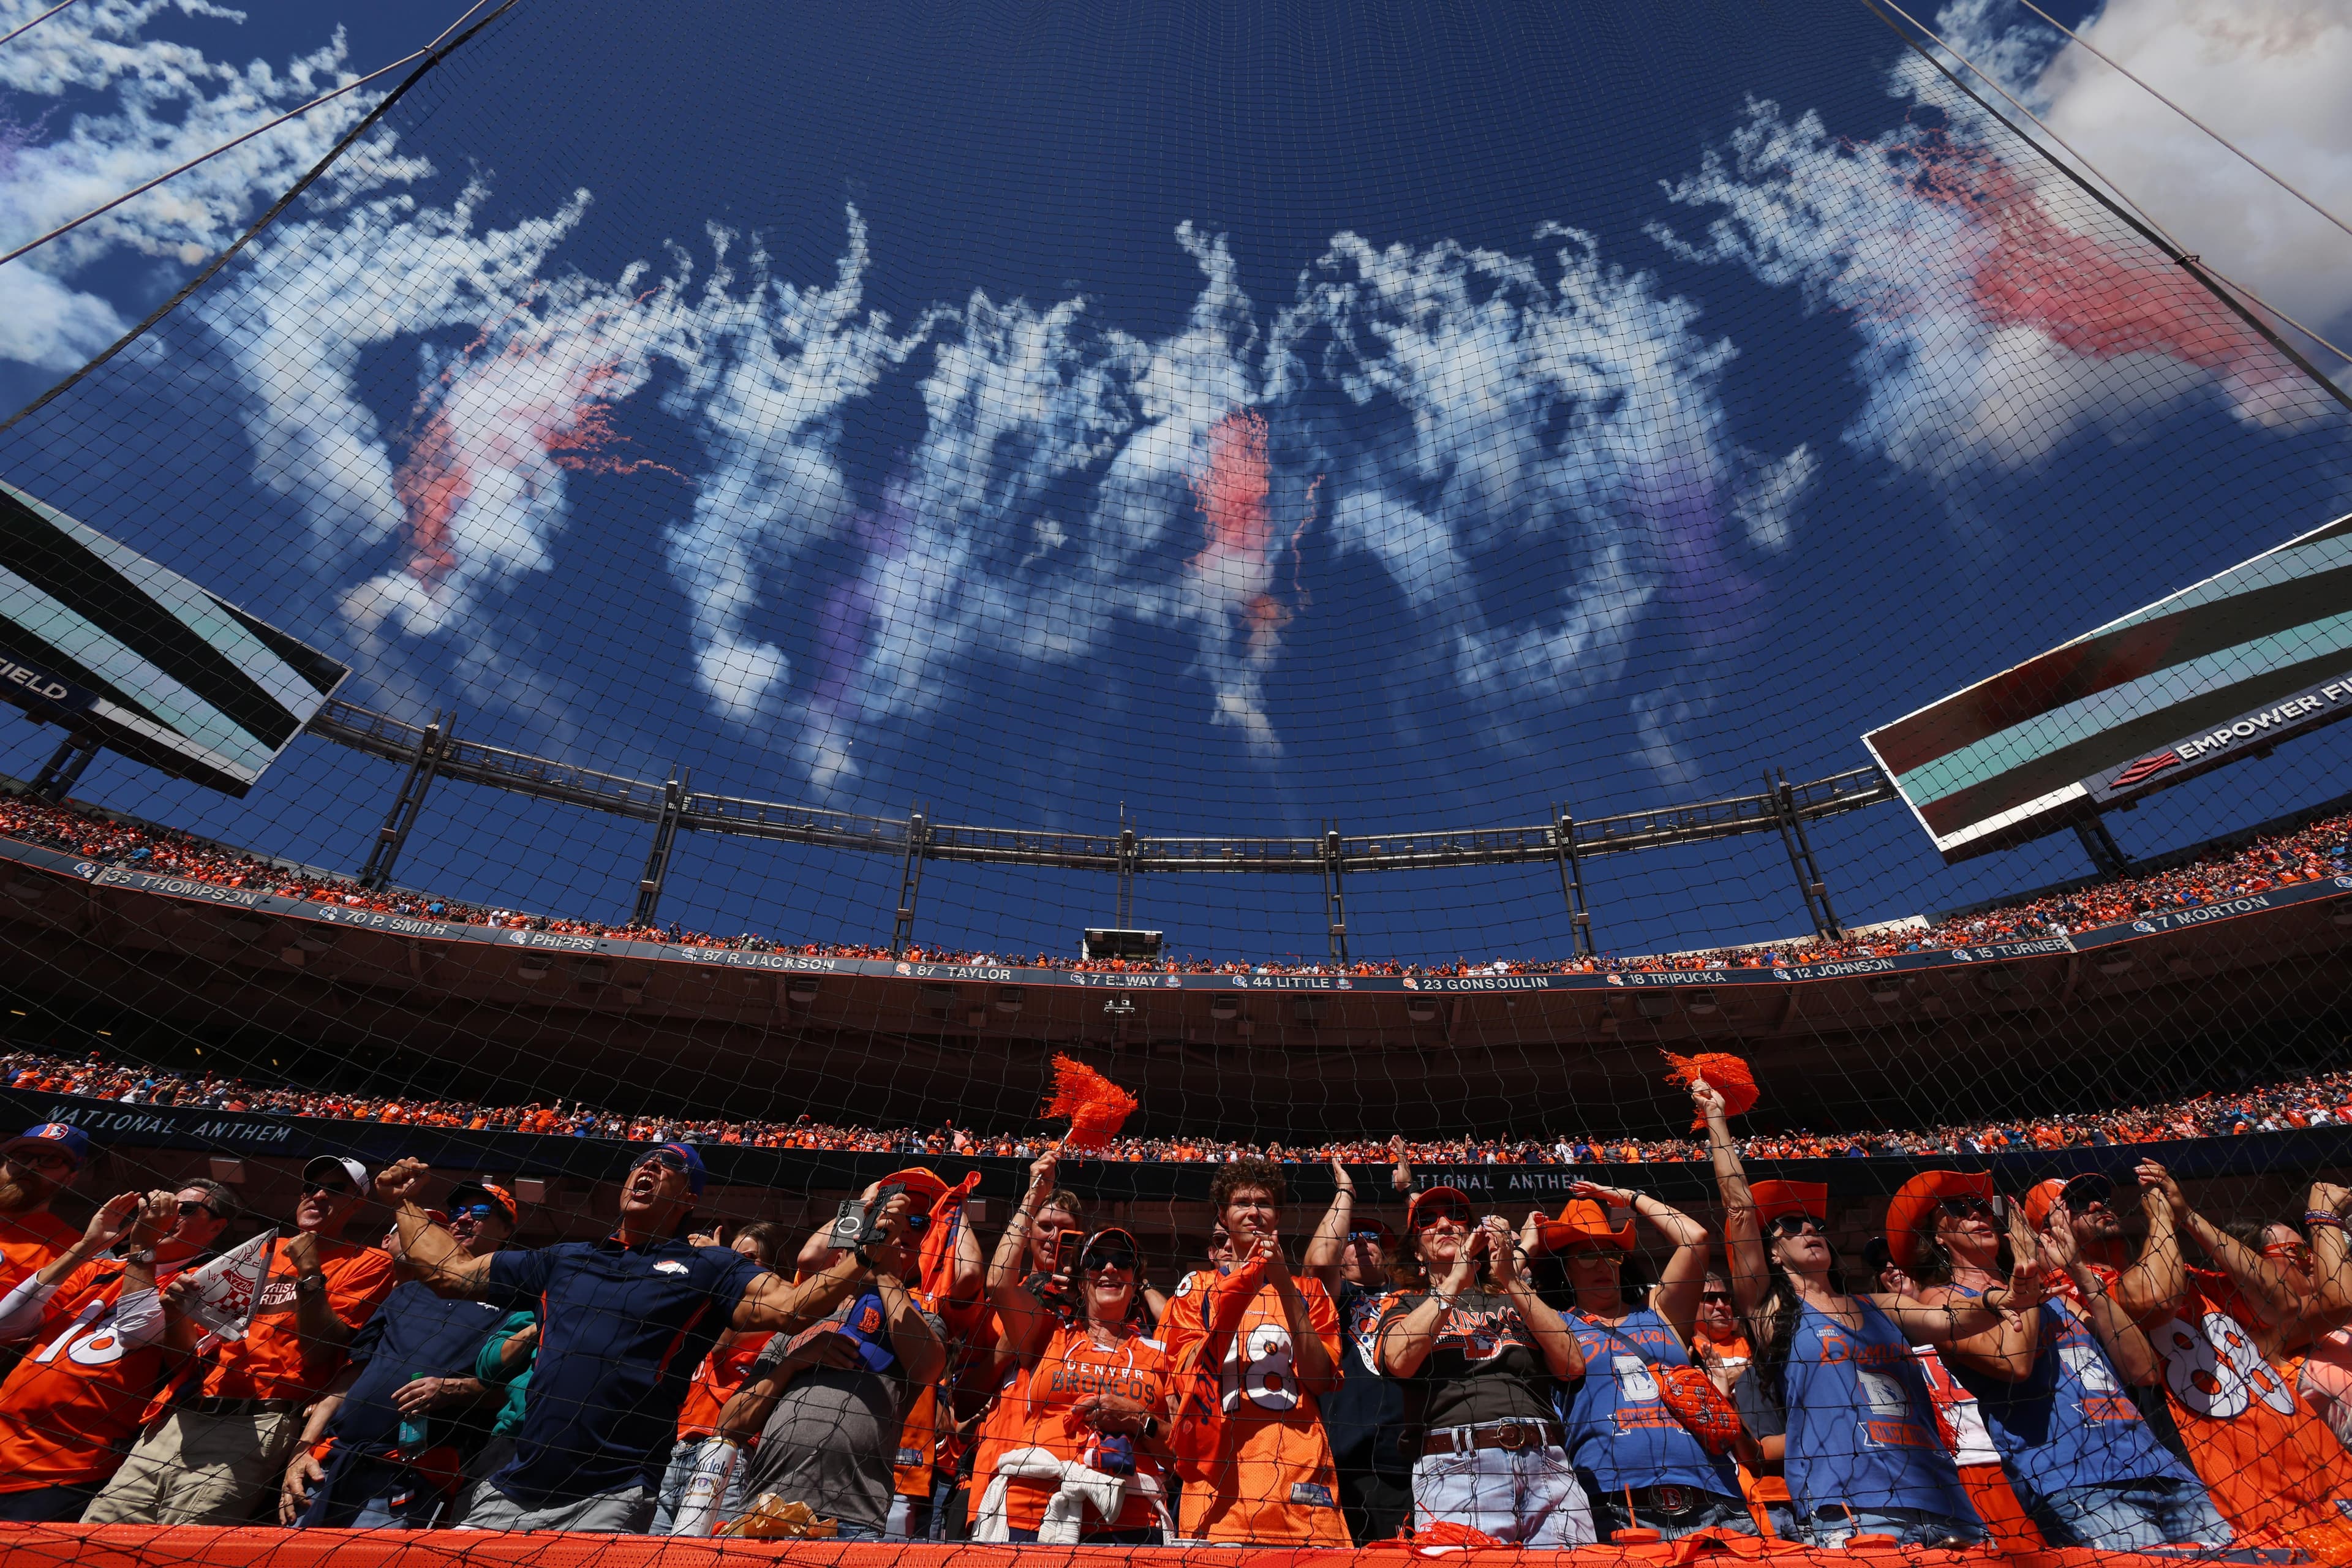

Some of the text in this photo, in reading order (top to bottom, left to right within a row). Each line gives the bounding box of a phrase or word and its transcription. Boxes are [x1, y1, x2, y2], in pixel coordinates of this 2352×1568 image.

[2176, 694, 2323, 760] EMPOWER
[106, 870, 258, 906] 36 THOMPSON
[344, 910, 367, 924] 70
[390, 918, 448, 936] SMITH
[2156, 895, 2271, 929] 7 MORTON
[531, 935, 595, 950] PHIPPS
[1975, 937, 2068, 959] 15 TURNER
[703, 949, 723, 962] 87
[746, 954, 835, 971] JACKSON
[1793, 957, 1896, 979] 12 JOHNSON
[917, 965, 1011, 981] 87 TAYLOR
[1091, 975, 1100, 986] 7
[1106, 975, 1159, 987] ELWAY
[1253, 976, 1272, 987] 44
[1277, 976, 1330, 989] LITTLE
[1423, 977, 1550, 990] 23 GONSOULIN
[1629, 971, 1727, 985] 18 TRIPUCKA
[50, 1105, 293, 1142] NATIONAL ANTHEM
[1392, 1174, 1586, 1189] TIONAL ANTHEM
[260, 1291, 297, 1305] RDLAN
[264, 1283, 290, 1294] THIS
[1066, 1359, 1144, 1380] DENVER
[1222, 1323, 1298, 1412] 18
[2149, 1311, 2296, 1419] 88
[1052, 1371, 1155, 1404] BRONCOS
